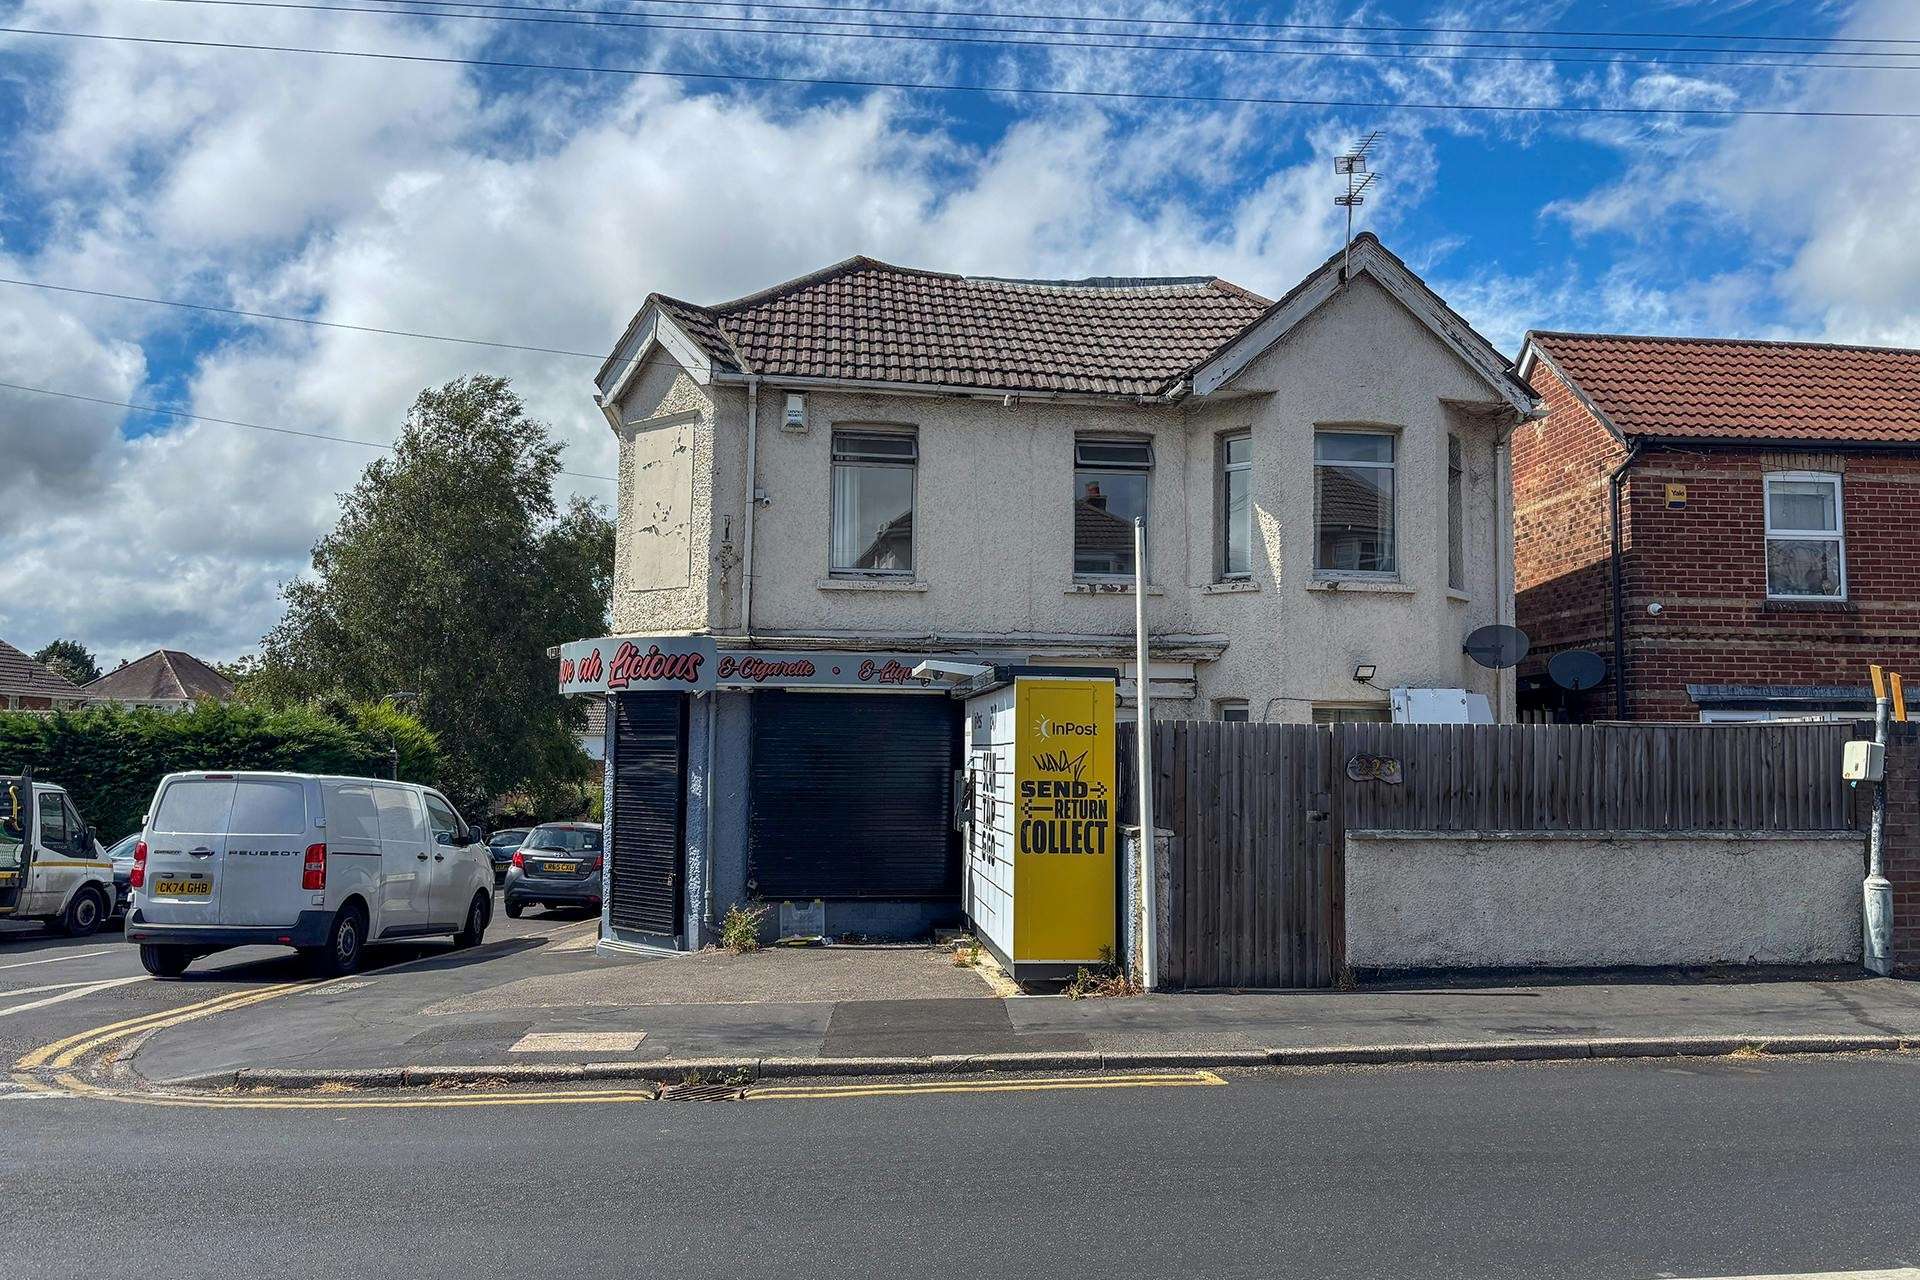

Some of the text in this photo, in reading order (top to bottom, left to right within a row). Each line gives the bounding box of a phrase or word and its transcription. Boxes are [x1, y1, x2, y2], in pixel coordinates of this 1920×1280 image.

[1670, 489, 1685, 497] Yale
[579, 648, 602, 683] ah
[608, 640, 705, 689] Licious
[718, 656, 816, 682] E-Cigarette
[1052, 721, 1098, 736] InPost
[1020, 780, 1089, 799] SEND
[1054, 799, 1108, 820] RETURN
[1020, 819, 1108, 855] COLLECT
[159, 882, 208, 893] CK74 GHB
